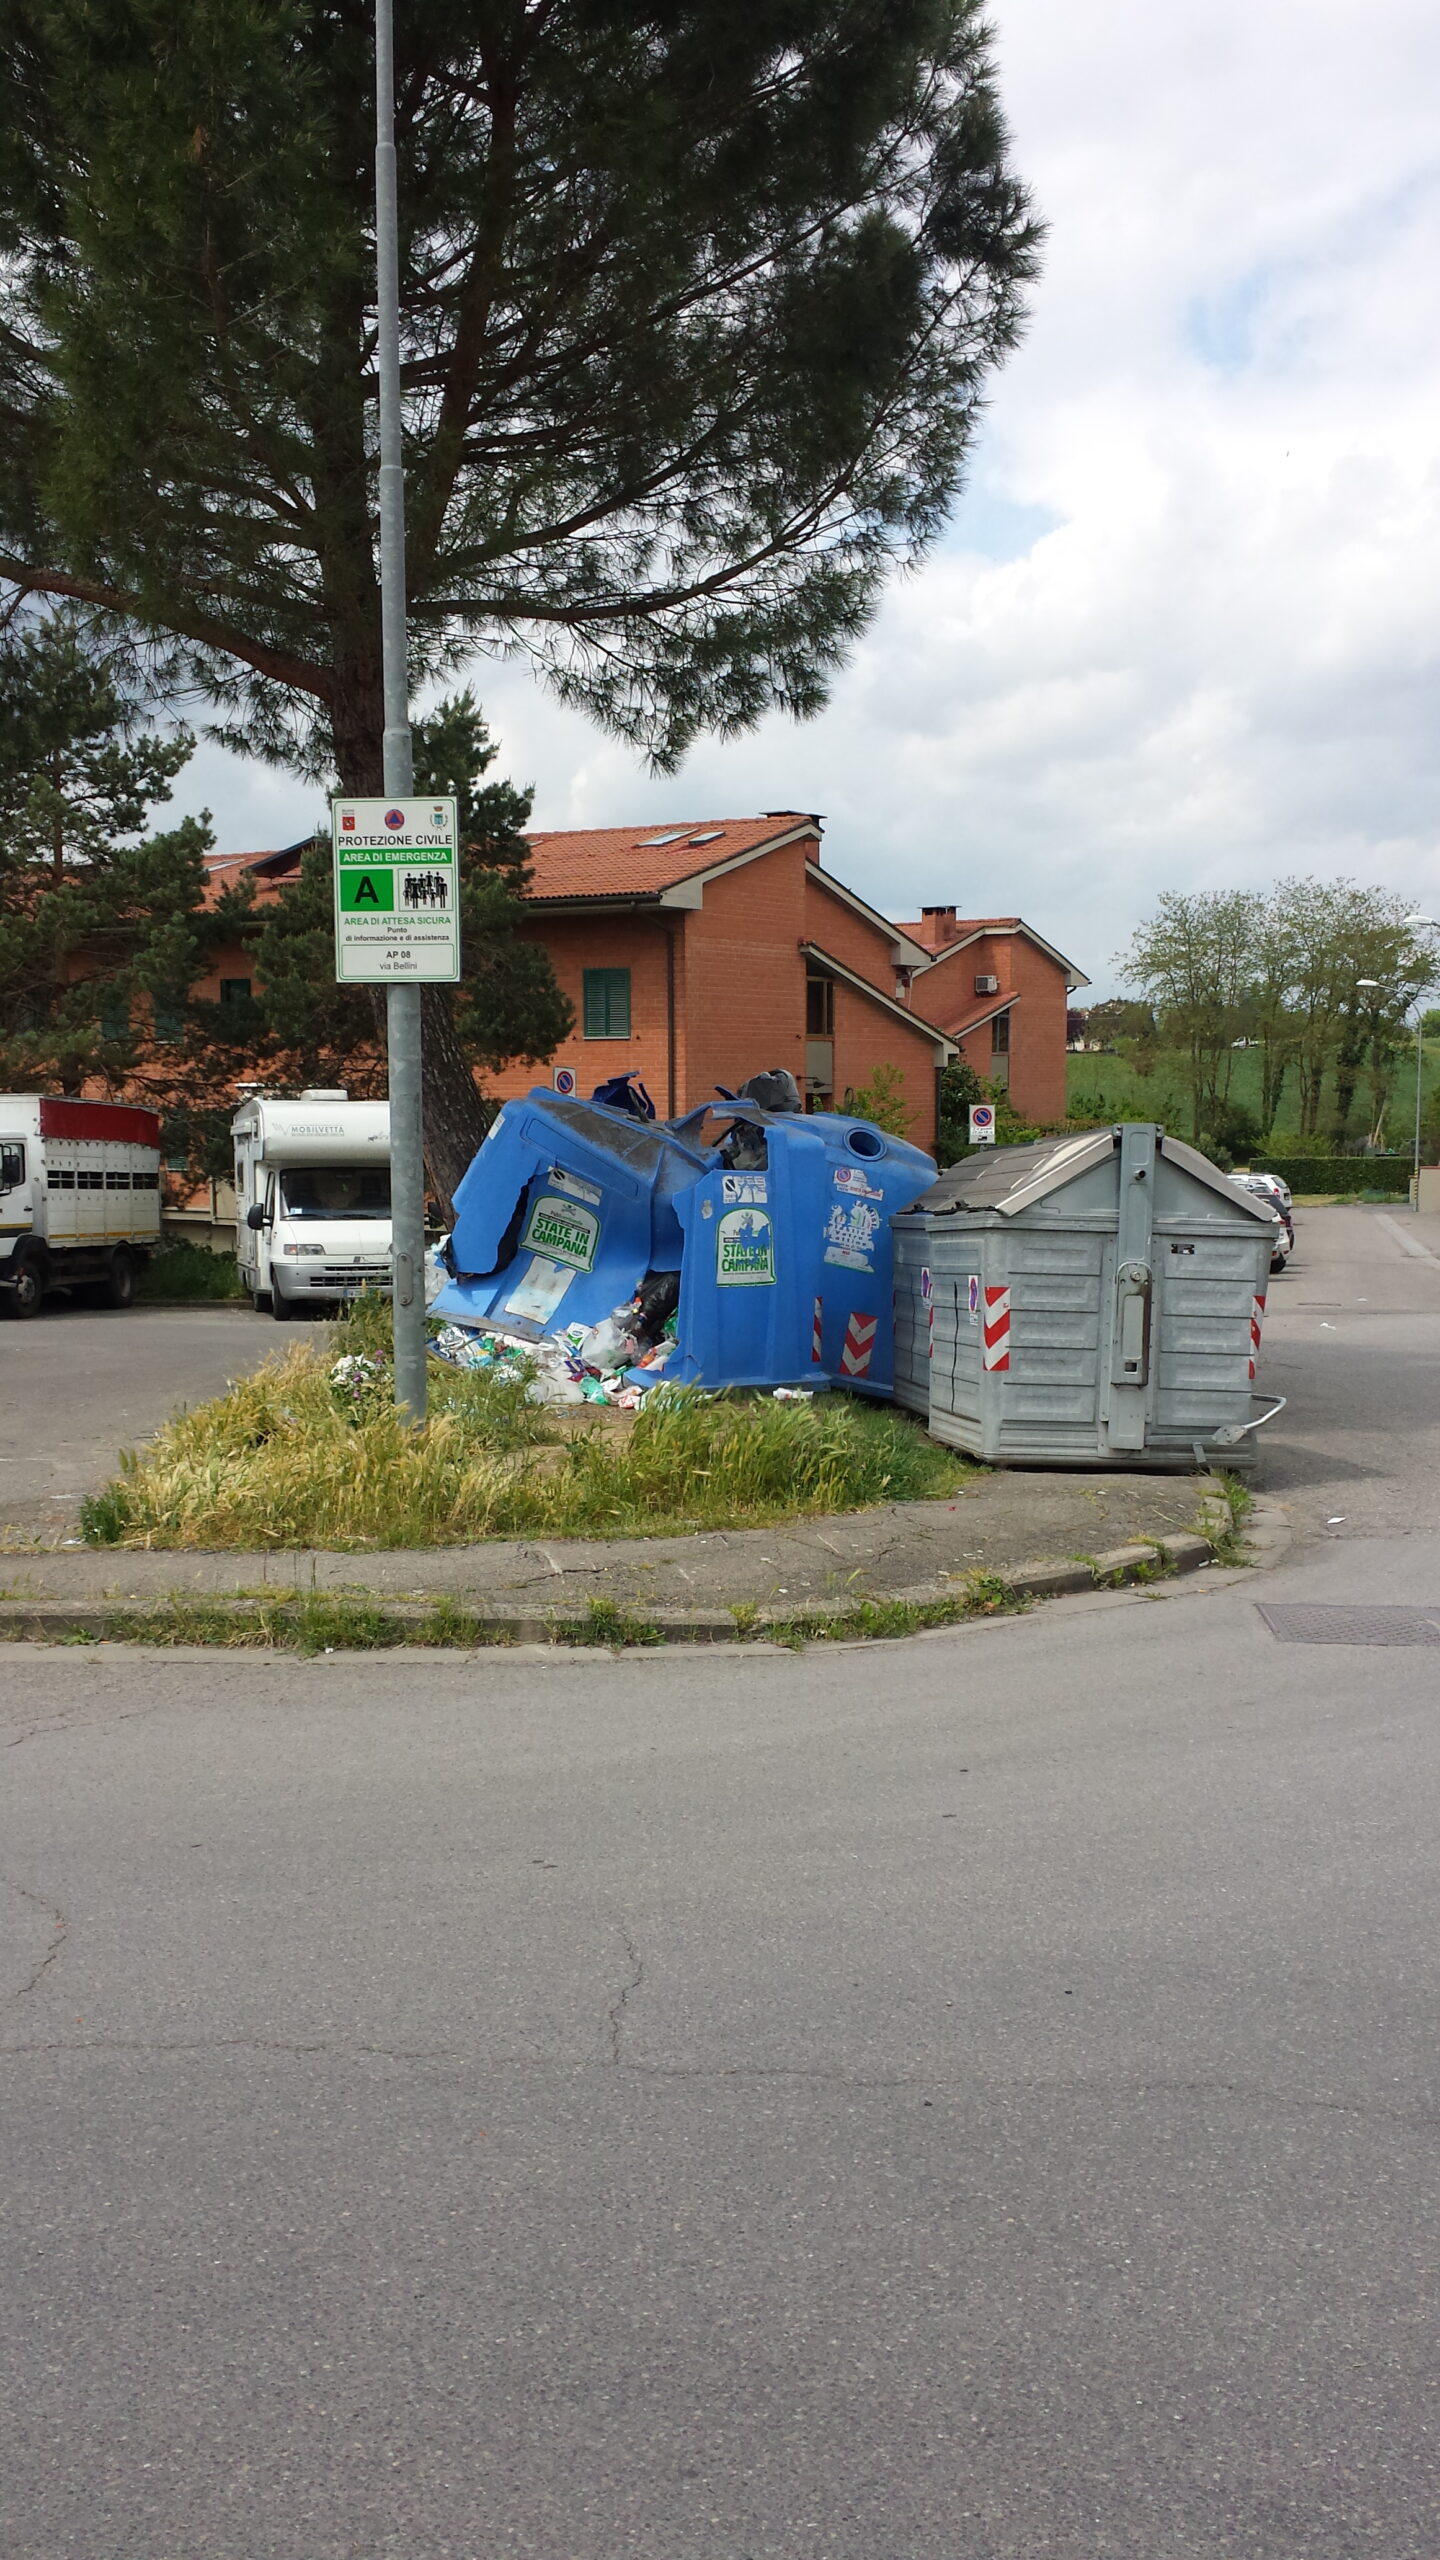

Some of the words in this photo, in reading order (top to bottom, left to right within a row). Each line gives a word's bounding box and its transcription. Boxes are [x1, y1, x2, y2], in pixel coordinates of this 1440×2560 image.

[338, 835, 412, 846] PROTEZIONE
[415, 835, 453, 845] CIVILE
[343, 853, 371, 862] AREA
[373, 853, 383, 861] DI
[385, 852, 448, 861] EMERGENZA
[354, 876, 379, 904] A
[344, 917, 369, 925] AREA
[371, 917, 380, 925] DI
[381, 917, 416, 925] ATTESA
[417, 916, 451, 925] SICURA
[386, 951, 398, 959] AP
[379, 962, 391, 970] via
[393, 962, 418, 970] Bellini
[536, 1218, 572, 1238] STATE
[575, 1232, 589, 1245] IN
[531, 1229, 588, 1257] CAMPANA
